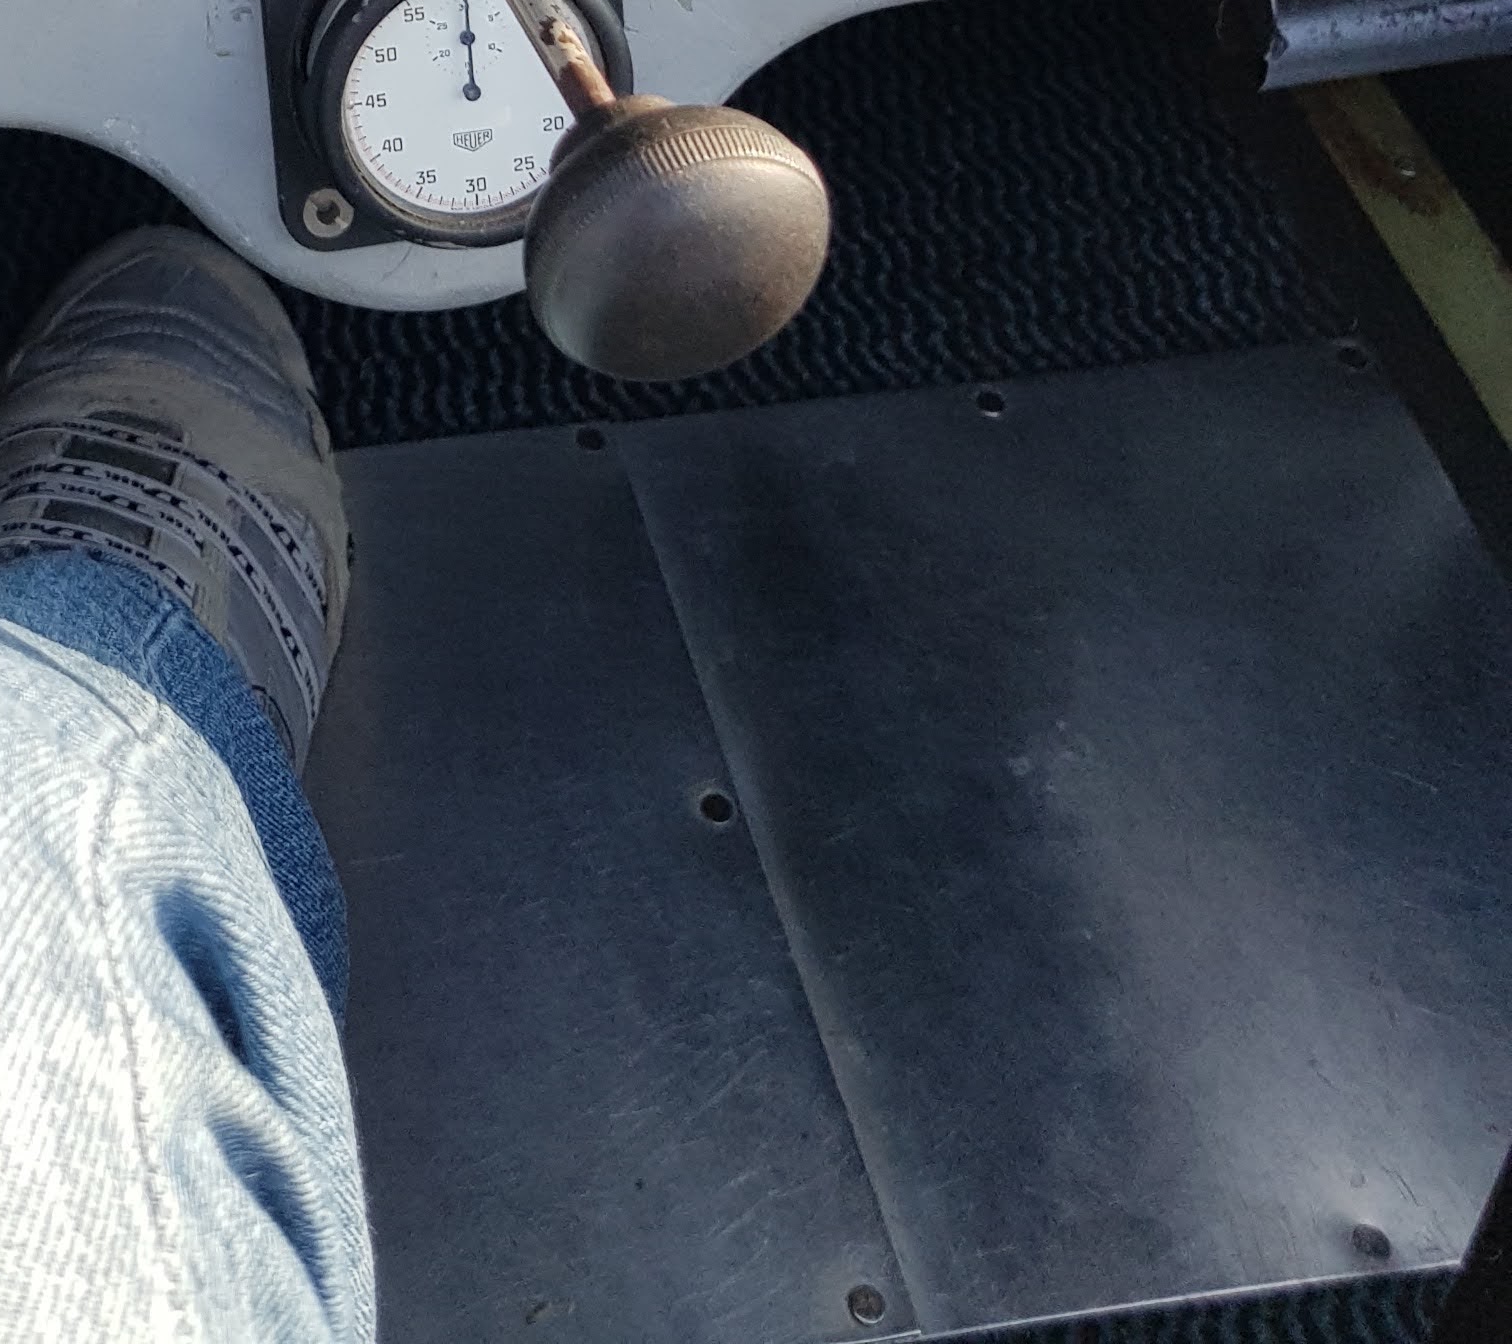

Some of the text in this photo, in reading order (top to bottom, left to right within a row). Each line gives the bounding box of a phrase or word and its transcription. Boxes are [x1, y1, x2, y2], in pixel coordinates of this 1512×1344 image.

[403, 7, 425, 22] 55
[374, 47, 397, 63] 50
[439, 49, 450, 57] 20
[365, 93, 387, 108] 45
[543, 116, 564, 131] 20
[381, 137, 404, 153] 40
[455, 131, 491, 149] HEUER
[513, 156, 535, 171] 25
[415, 170, 437, 184] 35
[465, 177, 487, 193] 30
